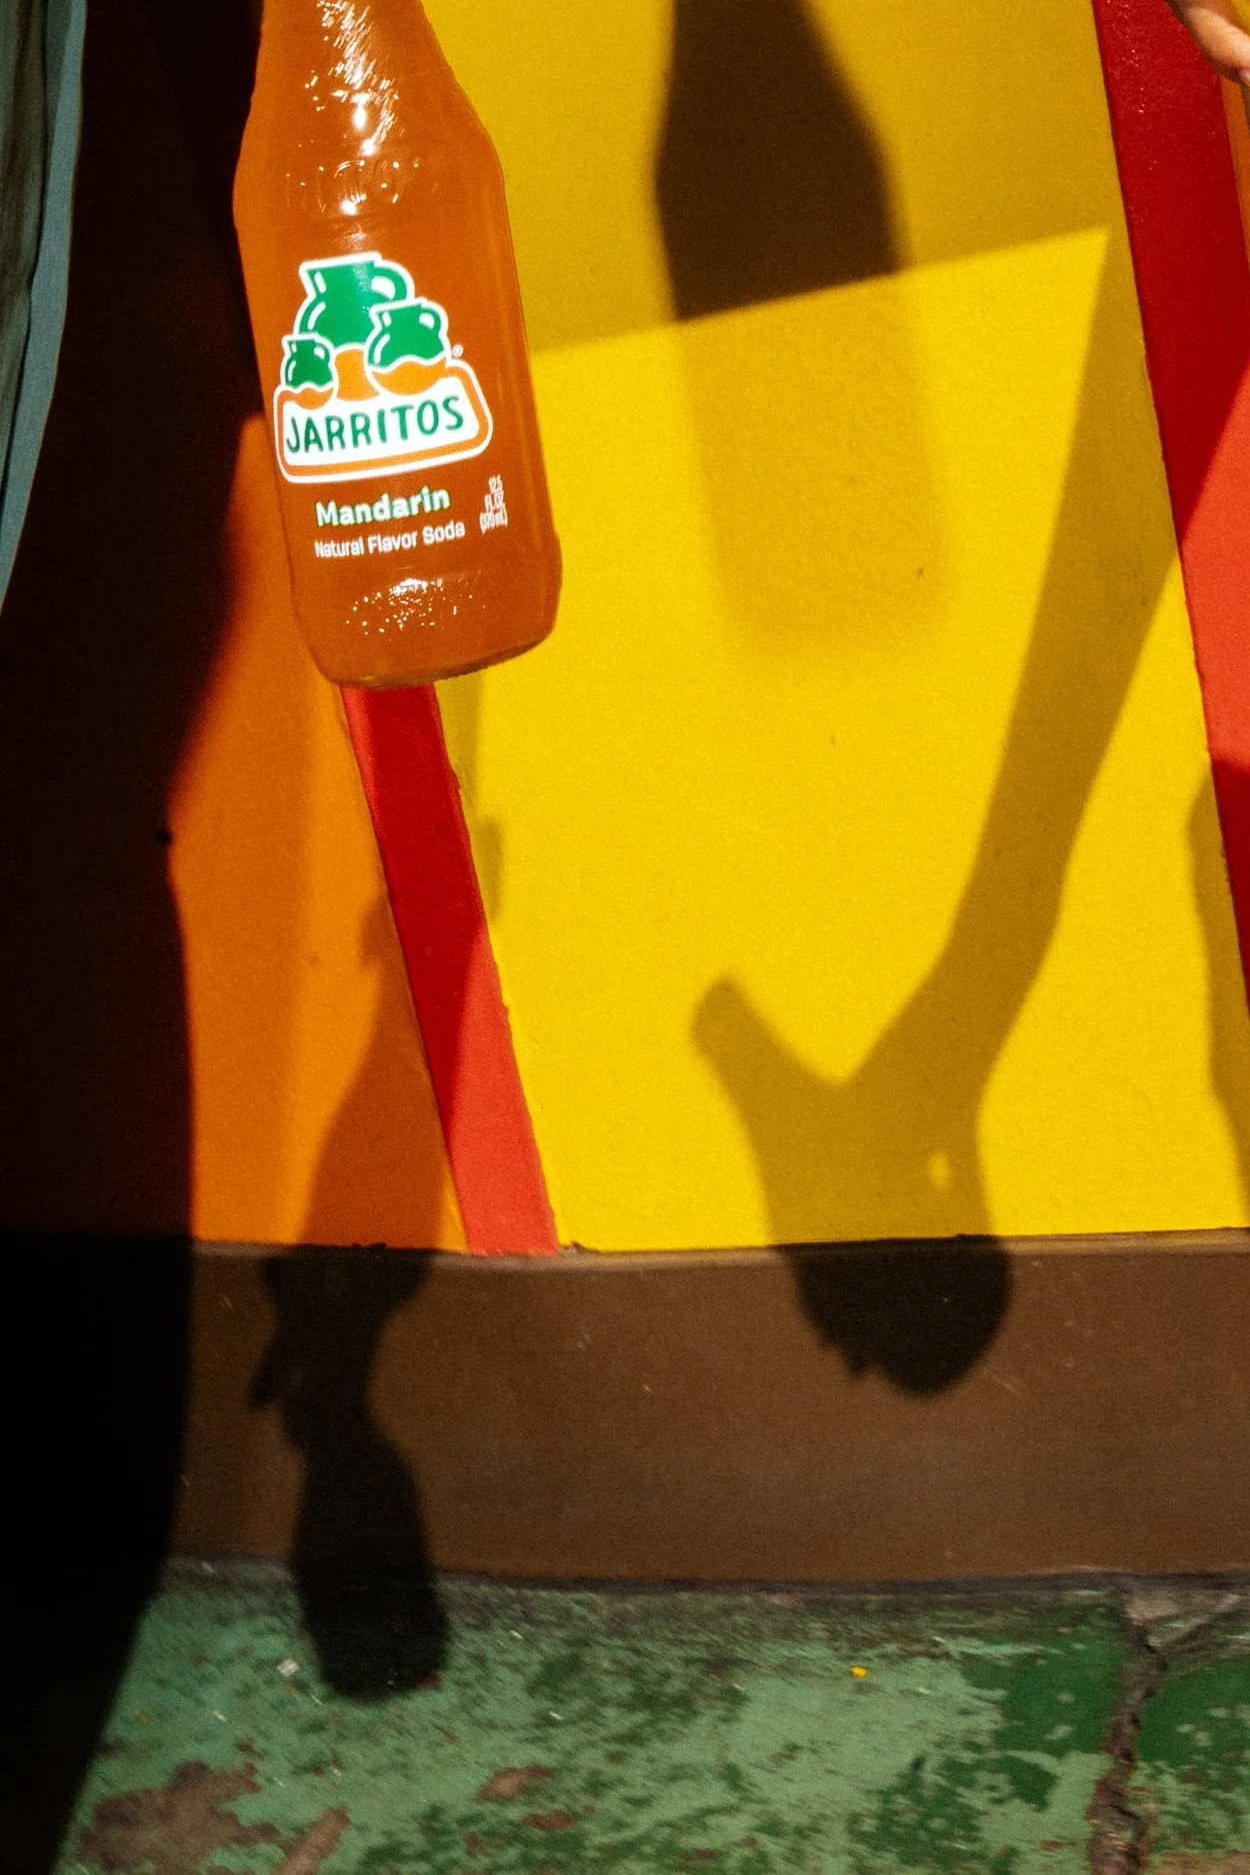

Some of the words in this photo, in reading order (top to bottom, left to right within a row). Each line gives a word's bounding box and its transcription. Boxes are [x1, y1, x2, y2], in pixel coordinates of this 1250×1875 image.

[286, 395, 464, 453] JARRITOS
[315, 485, 451, 527] Mandarin
[314, 536, 365, 558] Natural
[367, 530, 418, 554] Flavor
[422, 520, 466, 546] Soda
